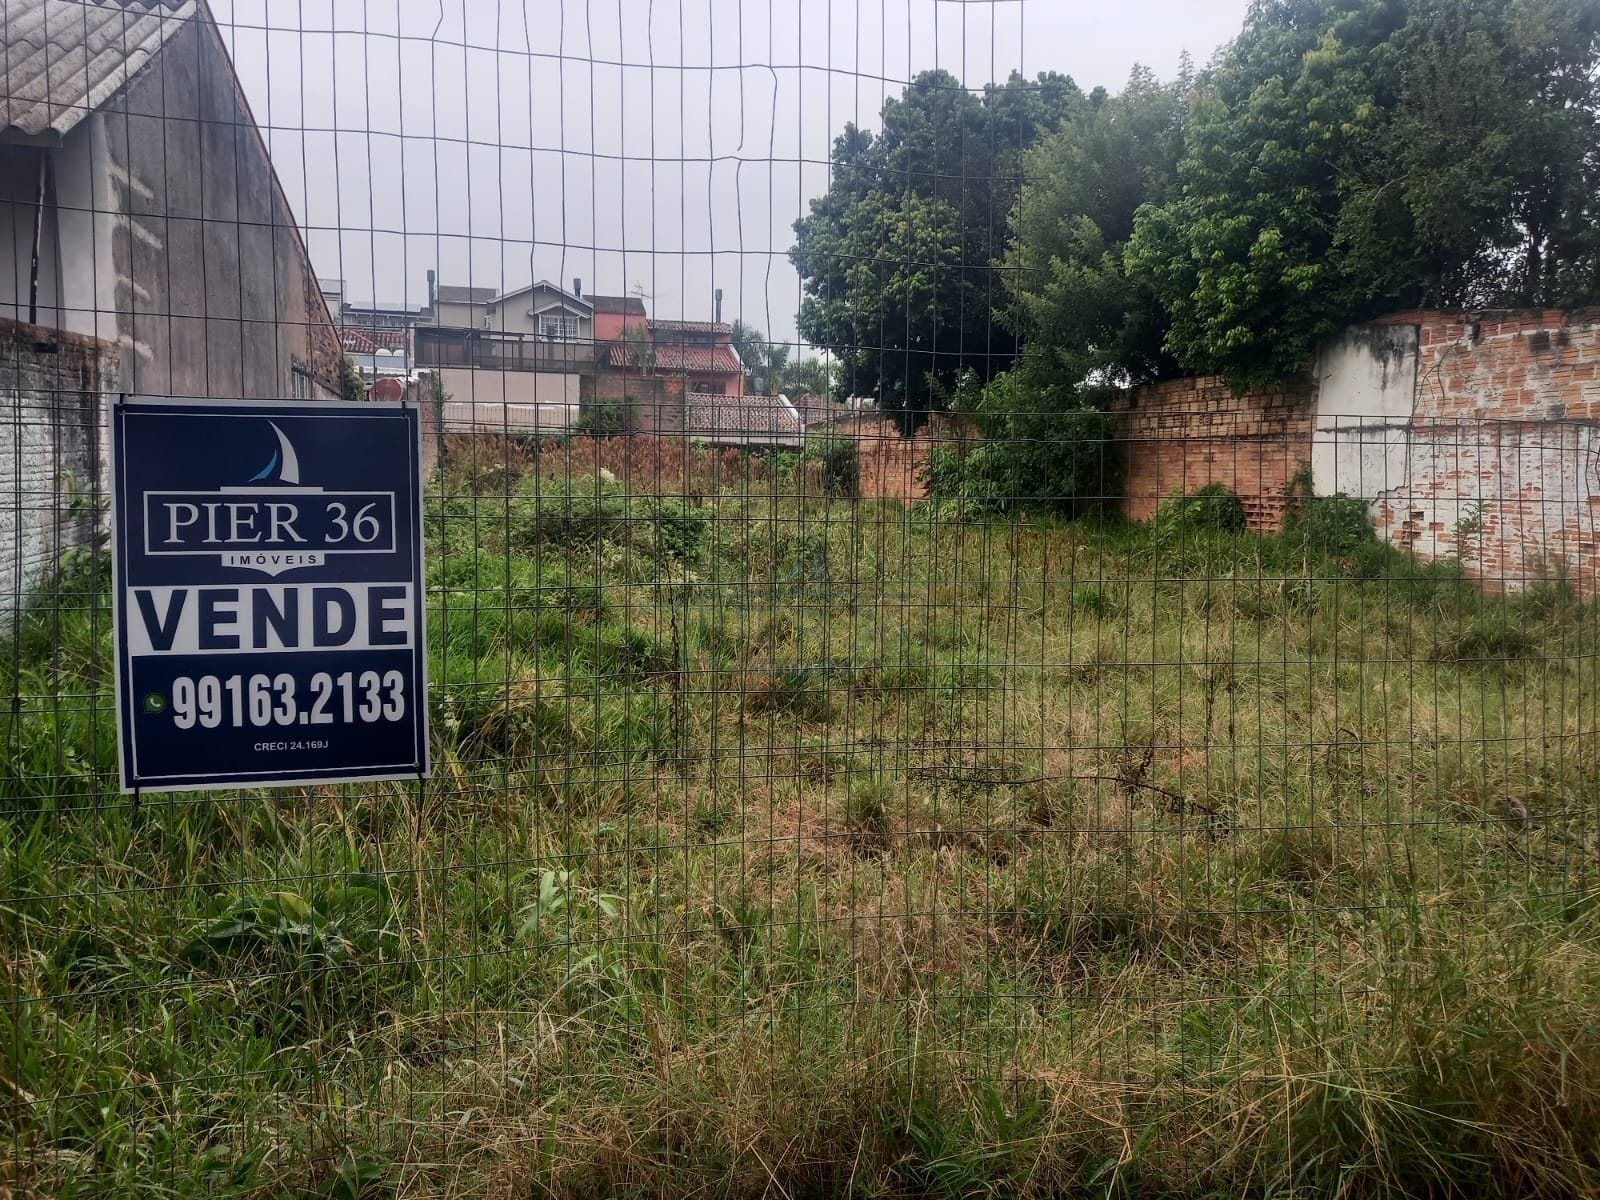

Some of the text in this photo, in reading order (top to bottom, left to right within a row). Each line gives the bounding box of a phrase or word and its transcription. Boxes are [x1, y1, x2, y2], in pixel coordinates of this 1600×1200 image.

[162, 502, 380, 544] PIER 36
[230, 553, 317, 565] IMÓVEIS
[134, 586, 408, 651] VENDE
[172, 670, 405, 729] 99163.2133
[254, 740, 329, 751] CRECI 24.169J
